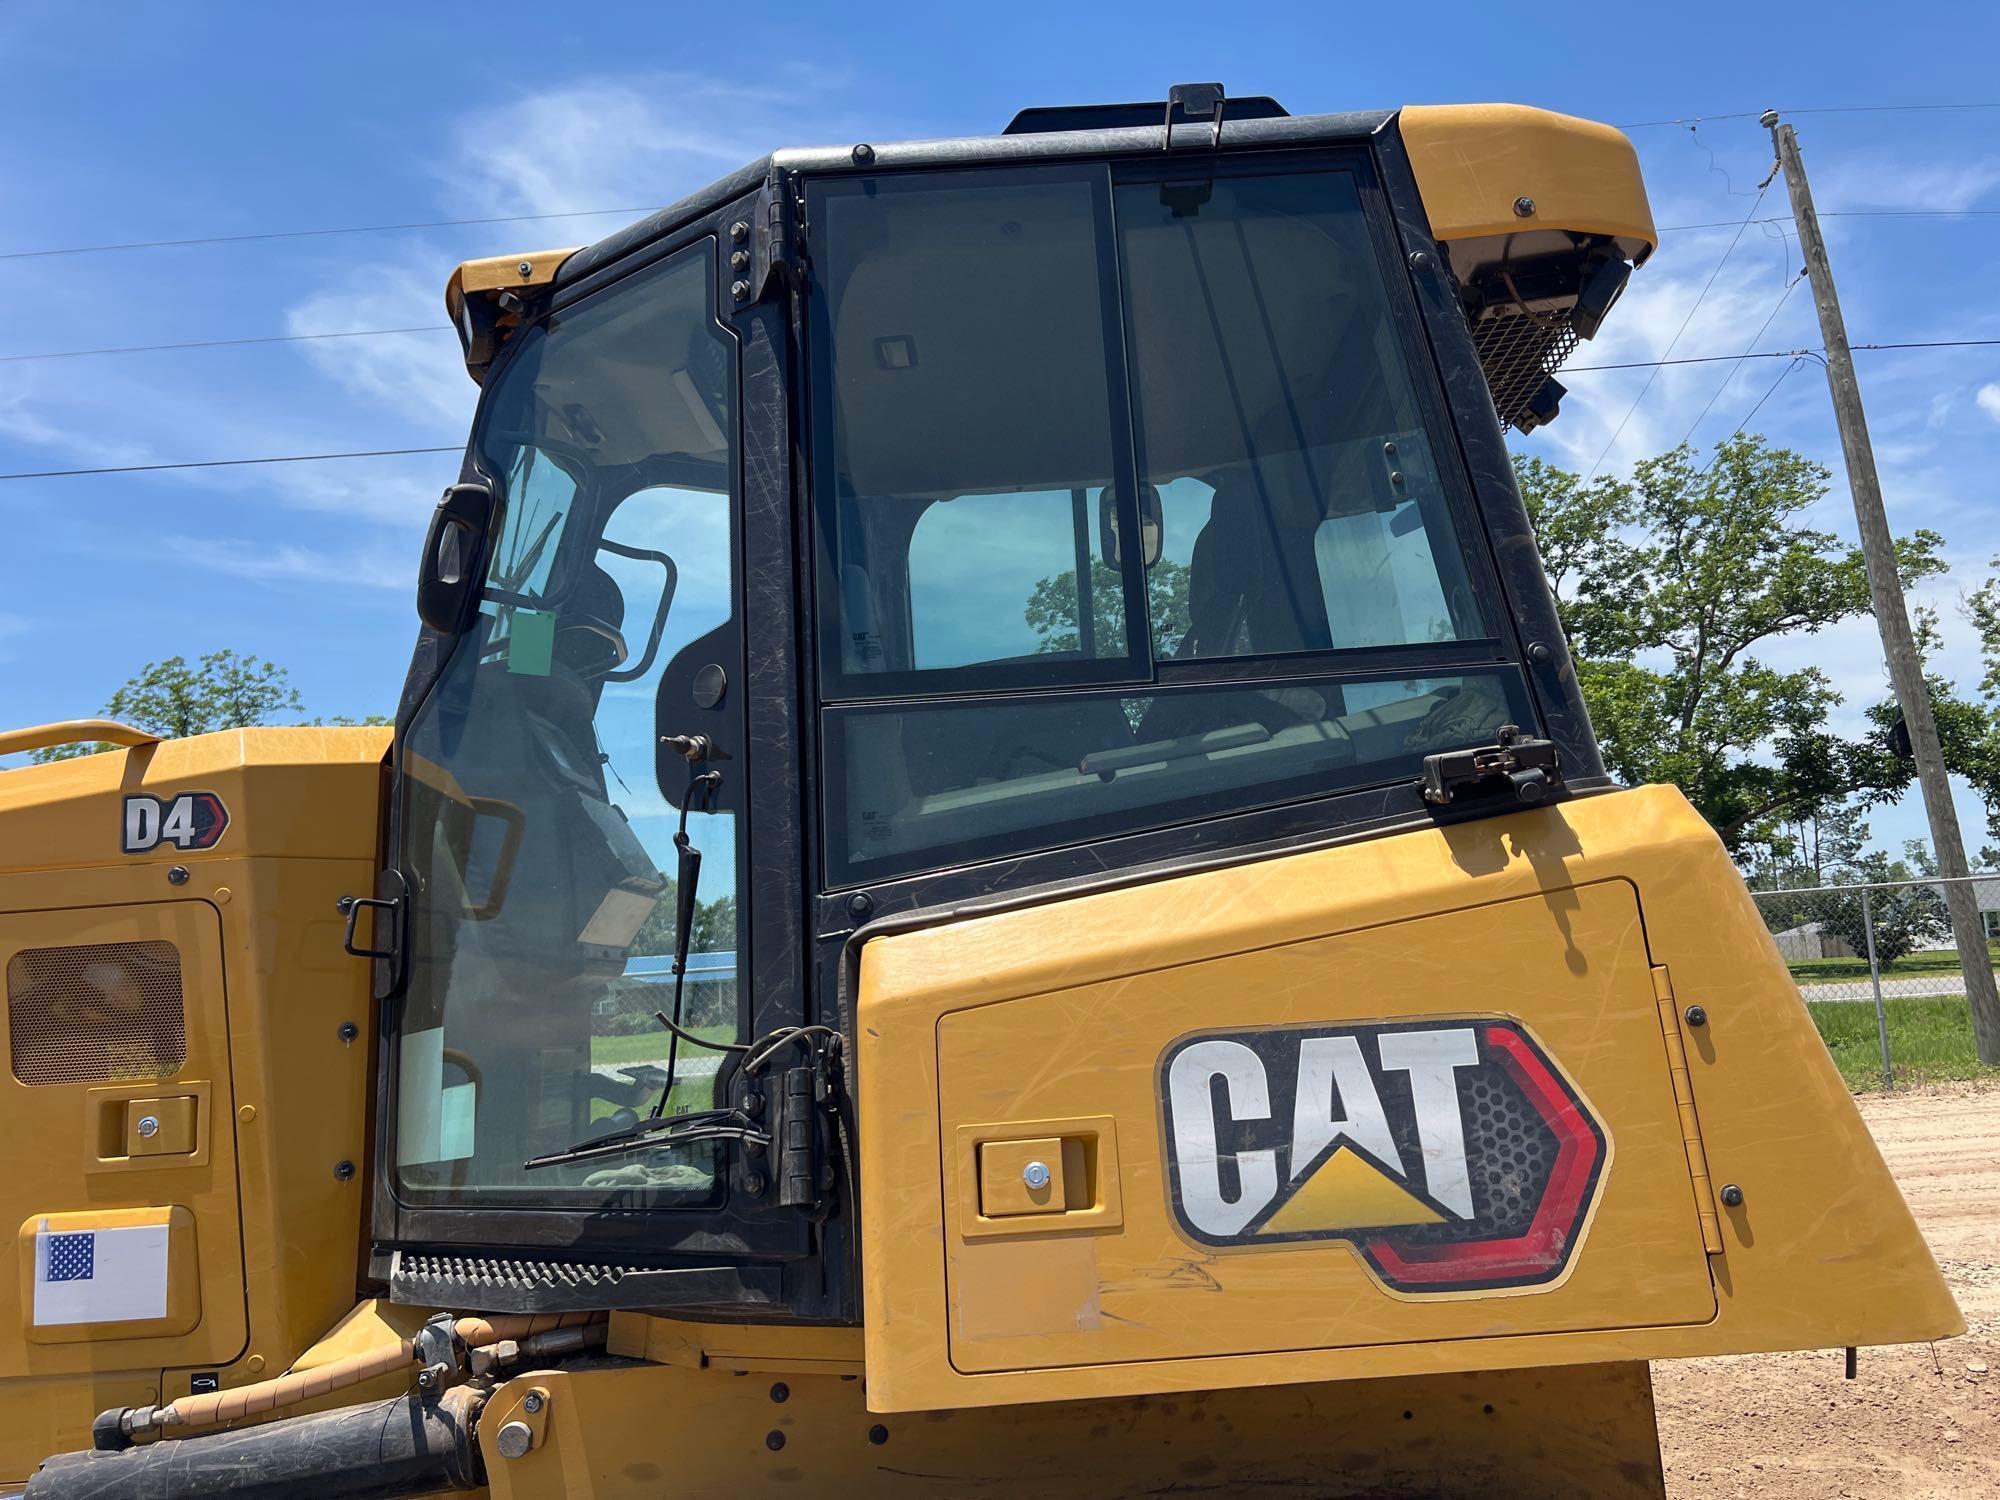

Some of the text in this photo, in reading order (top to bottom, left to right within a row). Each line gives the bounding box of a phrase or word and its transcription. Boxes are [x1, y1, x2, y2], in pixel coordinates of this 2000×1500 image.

[853, 632, 867, 640] CAT
[126, 796, 196, 850] D4
[1169, 1028, 1480, 1236] CAT
